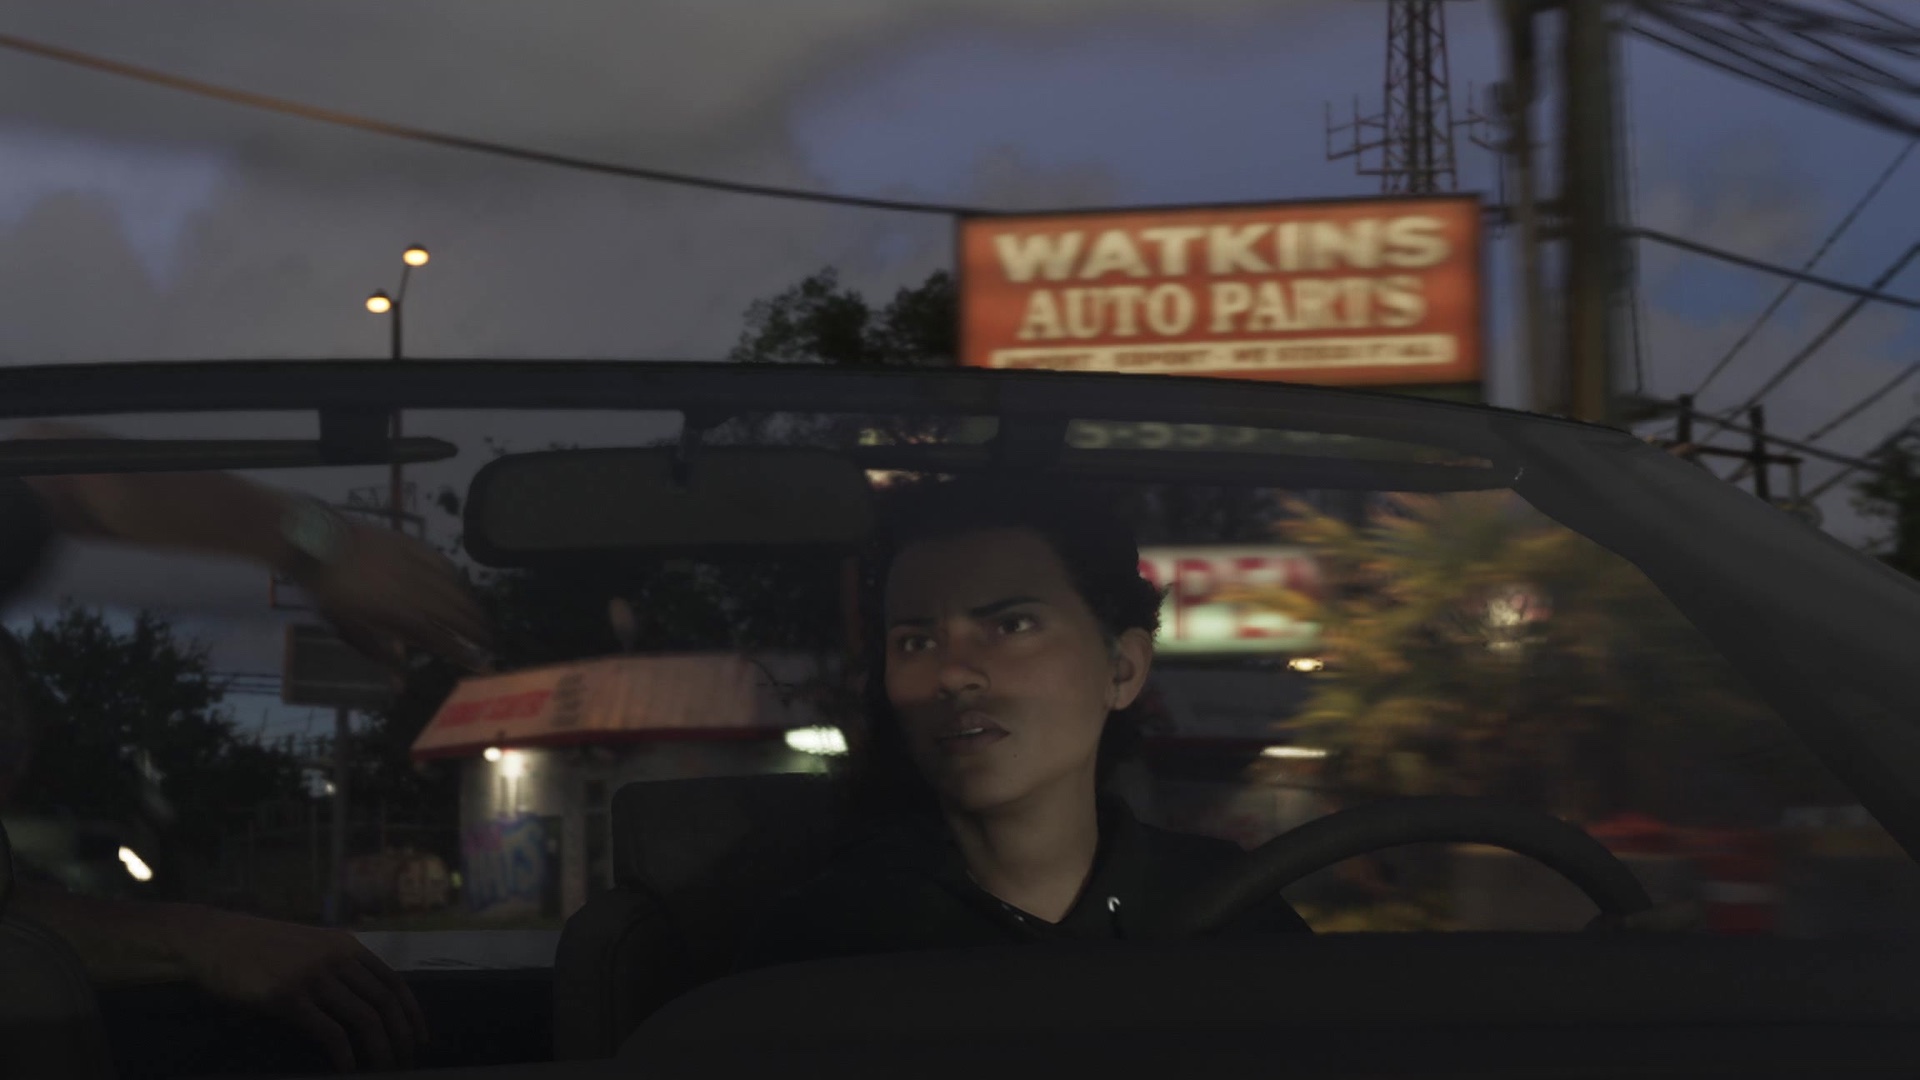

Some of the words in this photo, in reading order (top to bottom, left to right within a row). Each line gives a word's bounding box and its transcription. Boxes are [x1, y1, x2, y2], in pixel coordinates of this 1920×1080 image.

[994, 215, 1452, 283] WATKINS
[1016, 282, 1197, 341] AUTO
[1211, 274, 1426, 335] PARTS
